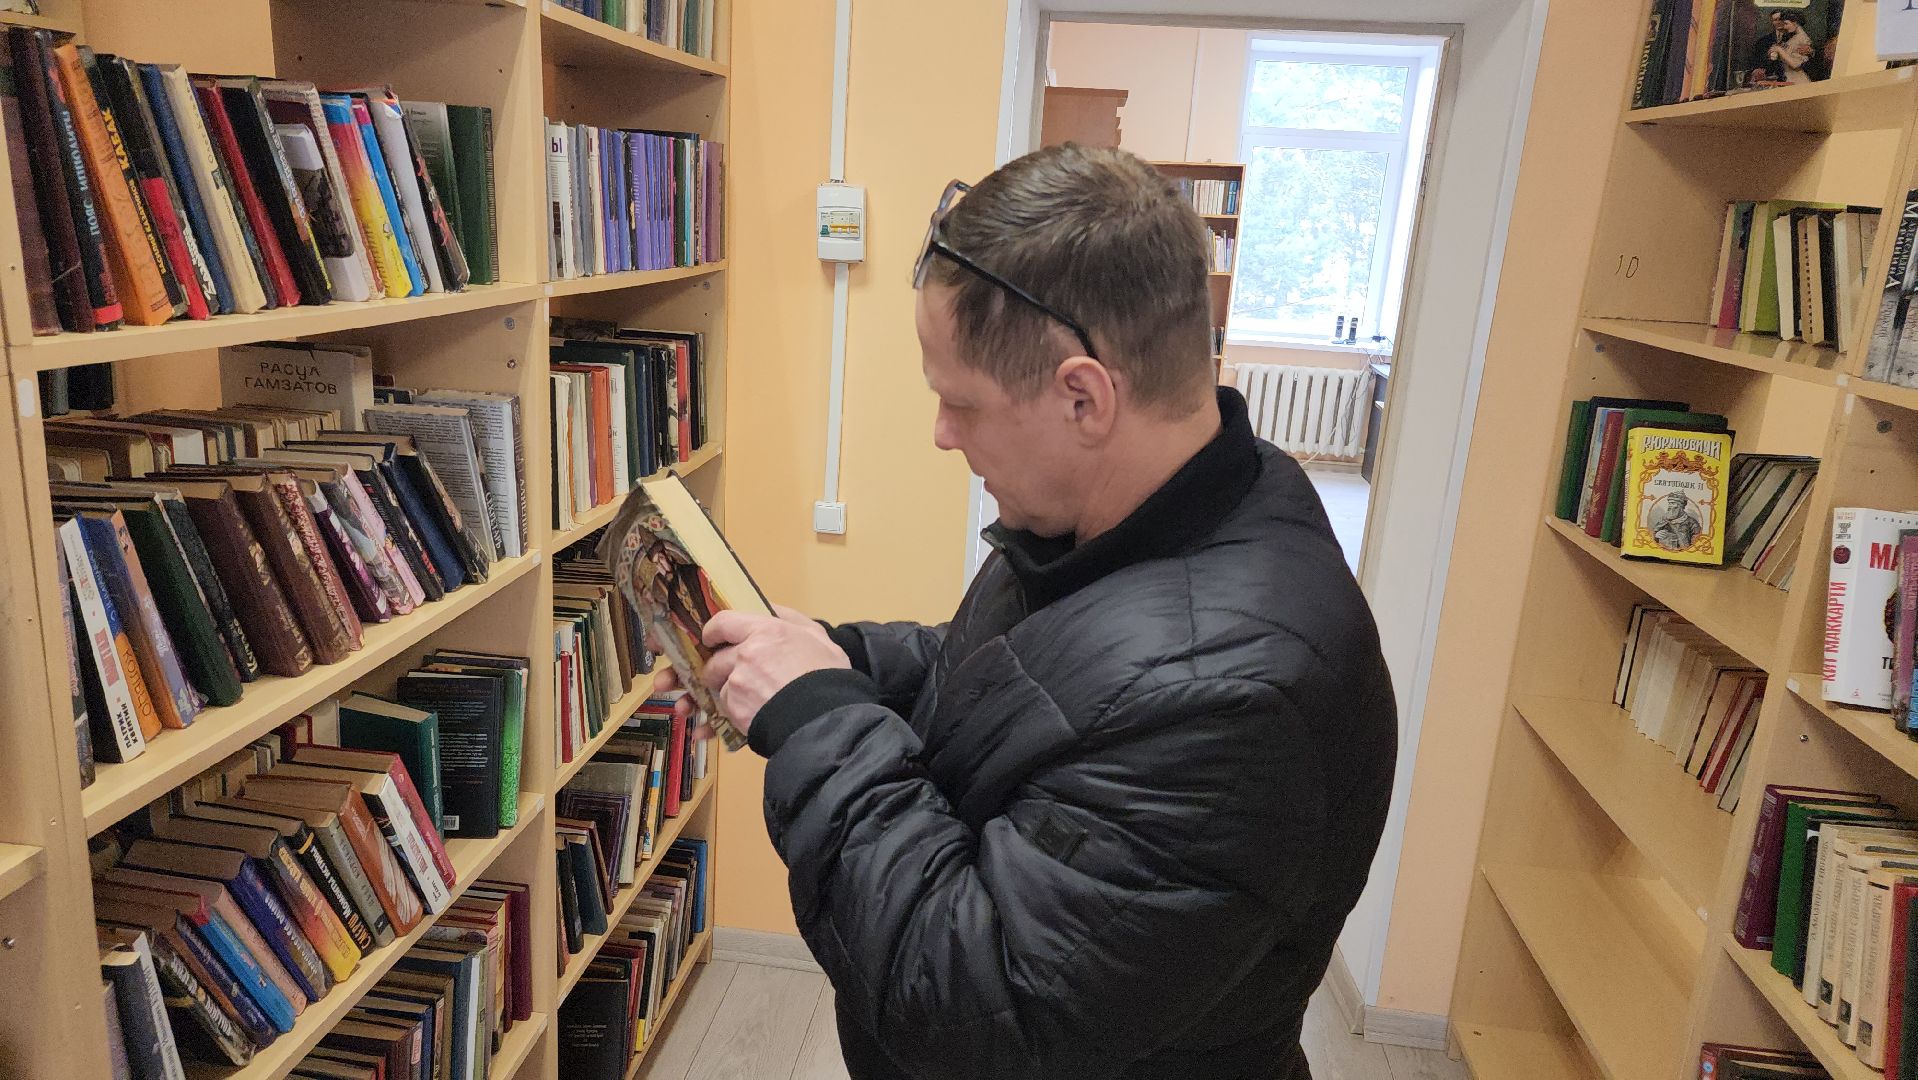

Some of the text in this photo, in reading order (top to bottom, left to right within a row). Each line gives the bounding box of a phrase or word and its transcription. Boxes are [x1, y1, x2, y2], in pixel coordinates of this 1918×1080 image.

[102, 107, 130, 170] КАБАК
[62, 110, 100, 236] ПОЯС ИППОЛИТЫ
[148, 233, 166, 274] ВАСИЛИЙ
[1614, 254, 1640, 279] 10
[244, 376, 337, 395] ГАМЗАТОВ
[260, 362, 321, 381] РАСУЛ
[1640, 434, 1722, 461] РЮРИКОВИЧИ
[485, 491, 503, 549] СЕКРЕТАРЬ
[1822, 581, 1848, 682] КИТ МАККАРТИ
[116, 711, 132, 748] ПАТРИК
[121, 702, 138, 744] КВЕНТИН
[347, 912, 371, 950] СМЕРШ
